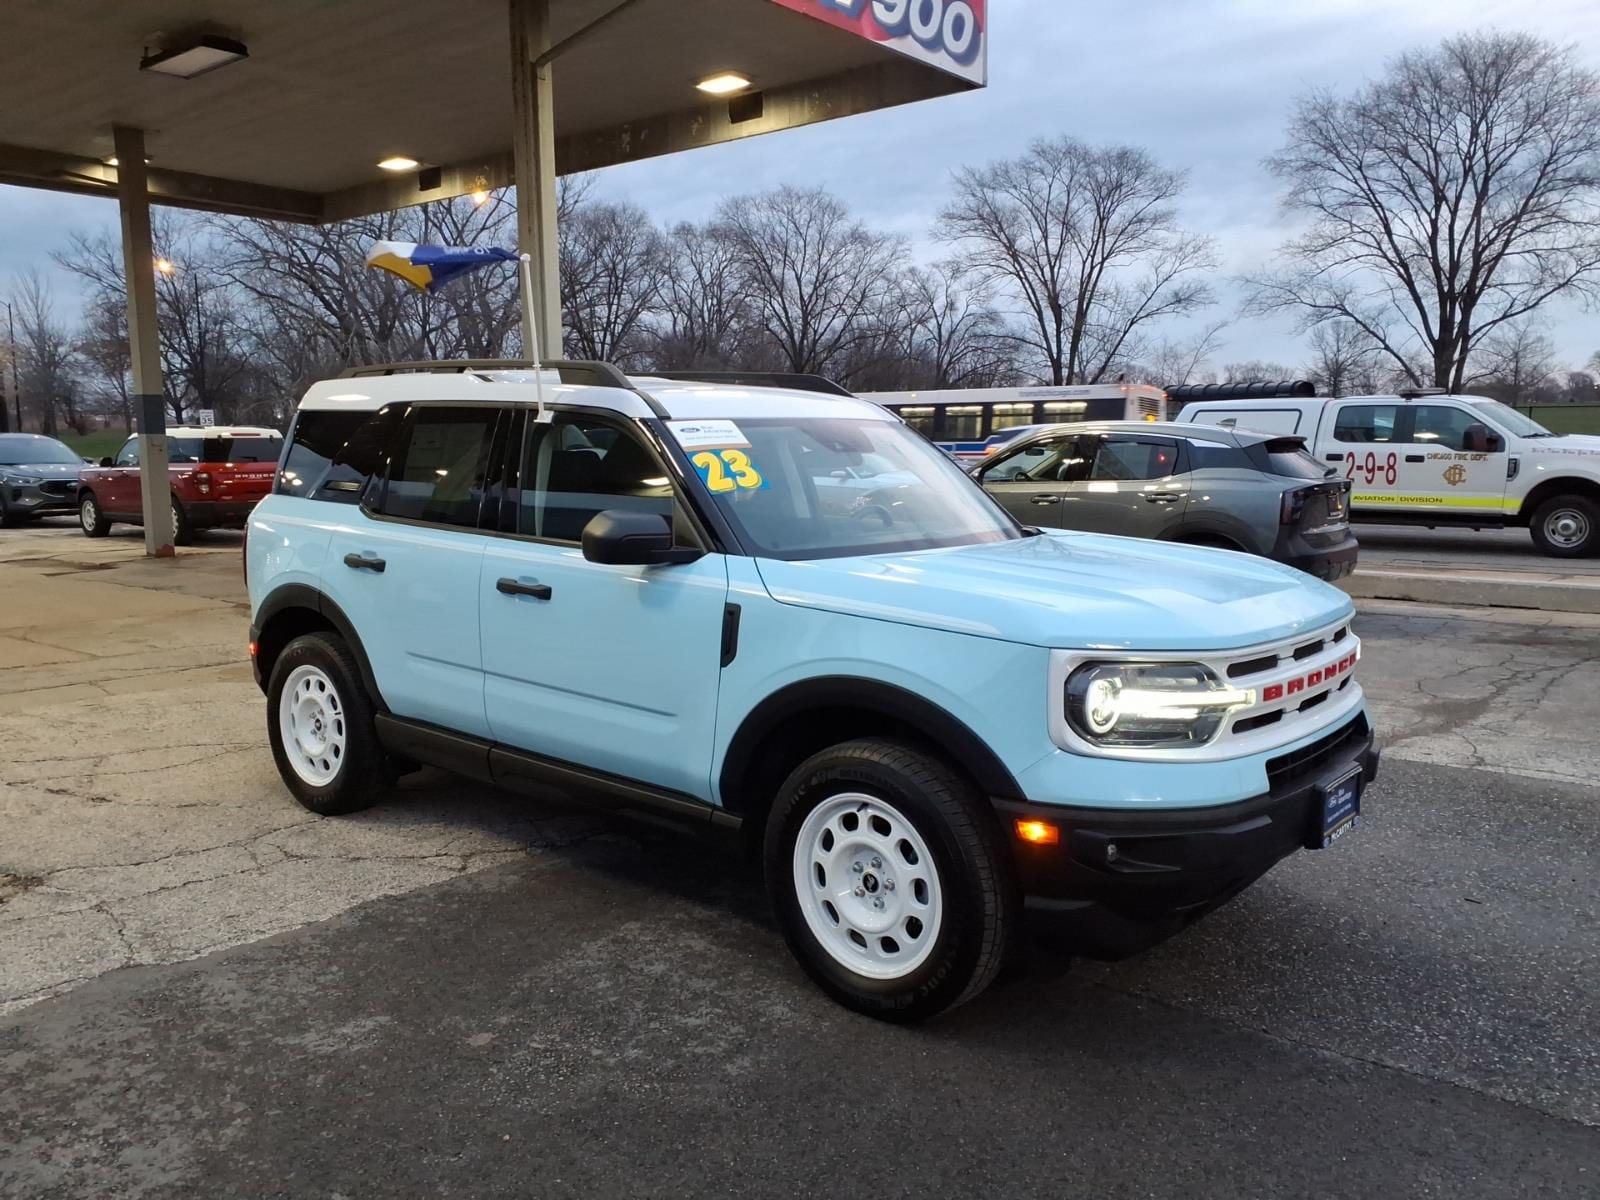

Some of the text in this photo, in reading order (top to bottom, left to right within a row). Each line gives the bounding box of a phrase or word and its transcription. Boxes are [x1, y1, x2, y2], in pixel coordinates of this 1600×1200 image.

[692, 449, 762, 491] 23
[1346, 451, 1397, 485] 2-9-8
[1426, 452, 1452, 461] CHICAGO
[1454, 453, 1469, 461] FIRE
